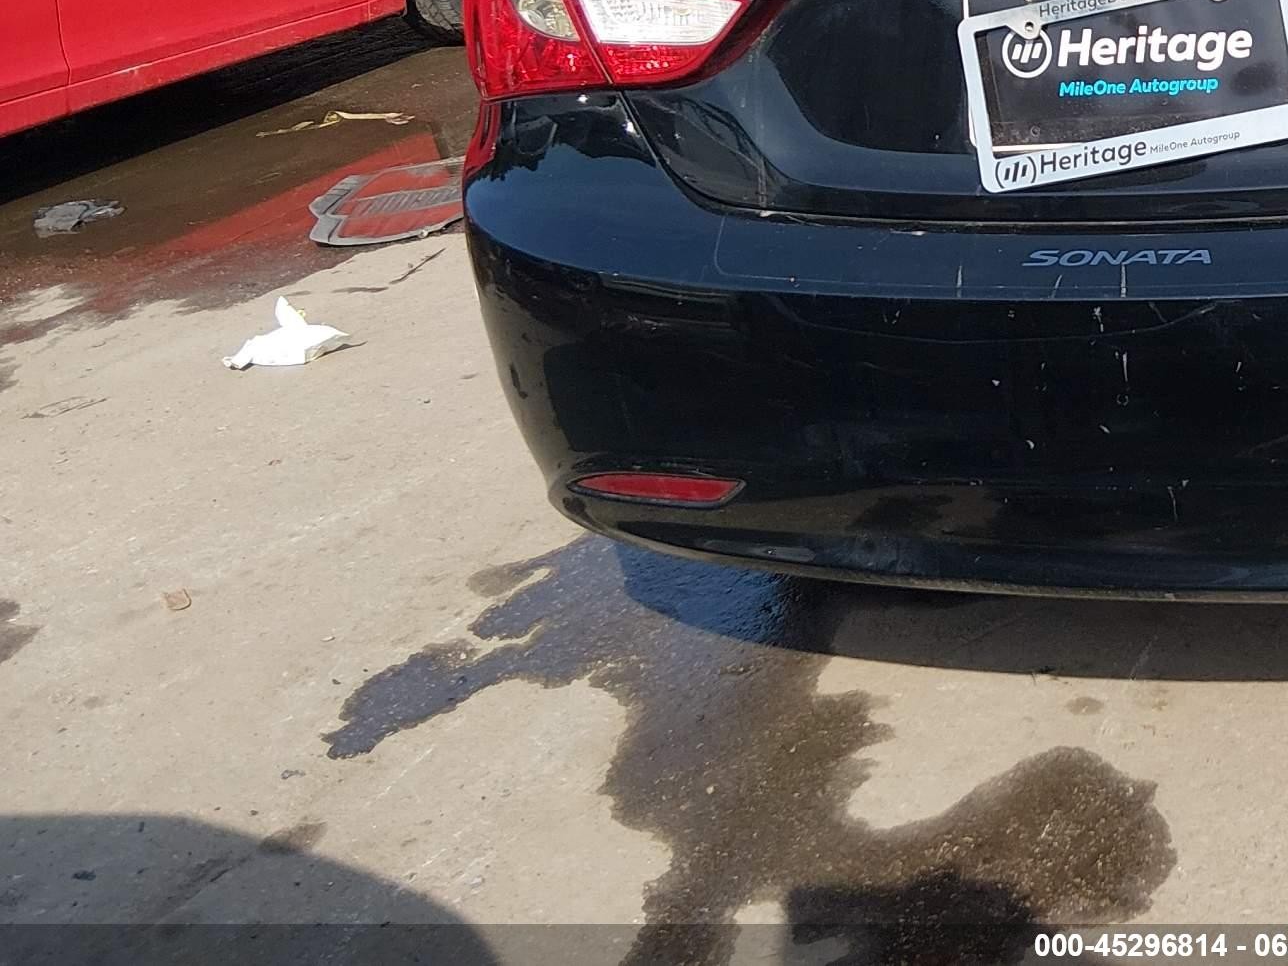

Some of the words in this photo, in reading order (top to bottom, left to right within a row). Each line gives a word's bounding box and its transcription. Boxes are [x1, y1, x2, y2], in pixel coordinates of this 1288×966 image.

[1057, 25, 1253, 72] Heritage
[1059, 80, 1126, 97] MileOne
[1129, 78, 1219, 96] Autogroup
[1040, 141, 1147, 174] Heritage
[1150, 141, 1188, 155] MileOne
[1190, 131, 1241, 147] Autogroup
[1022, 249, 1212, 267] SONATA
